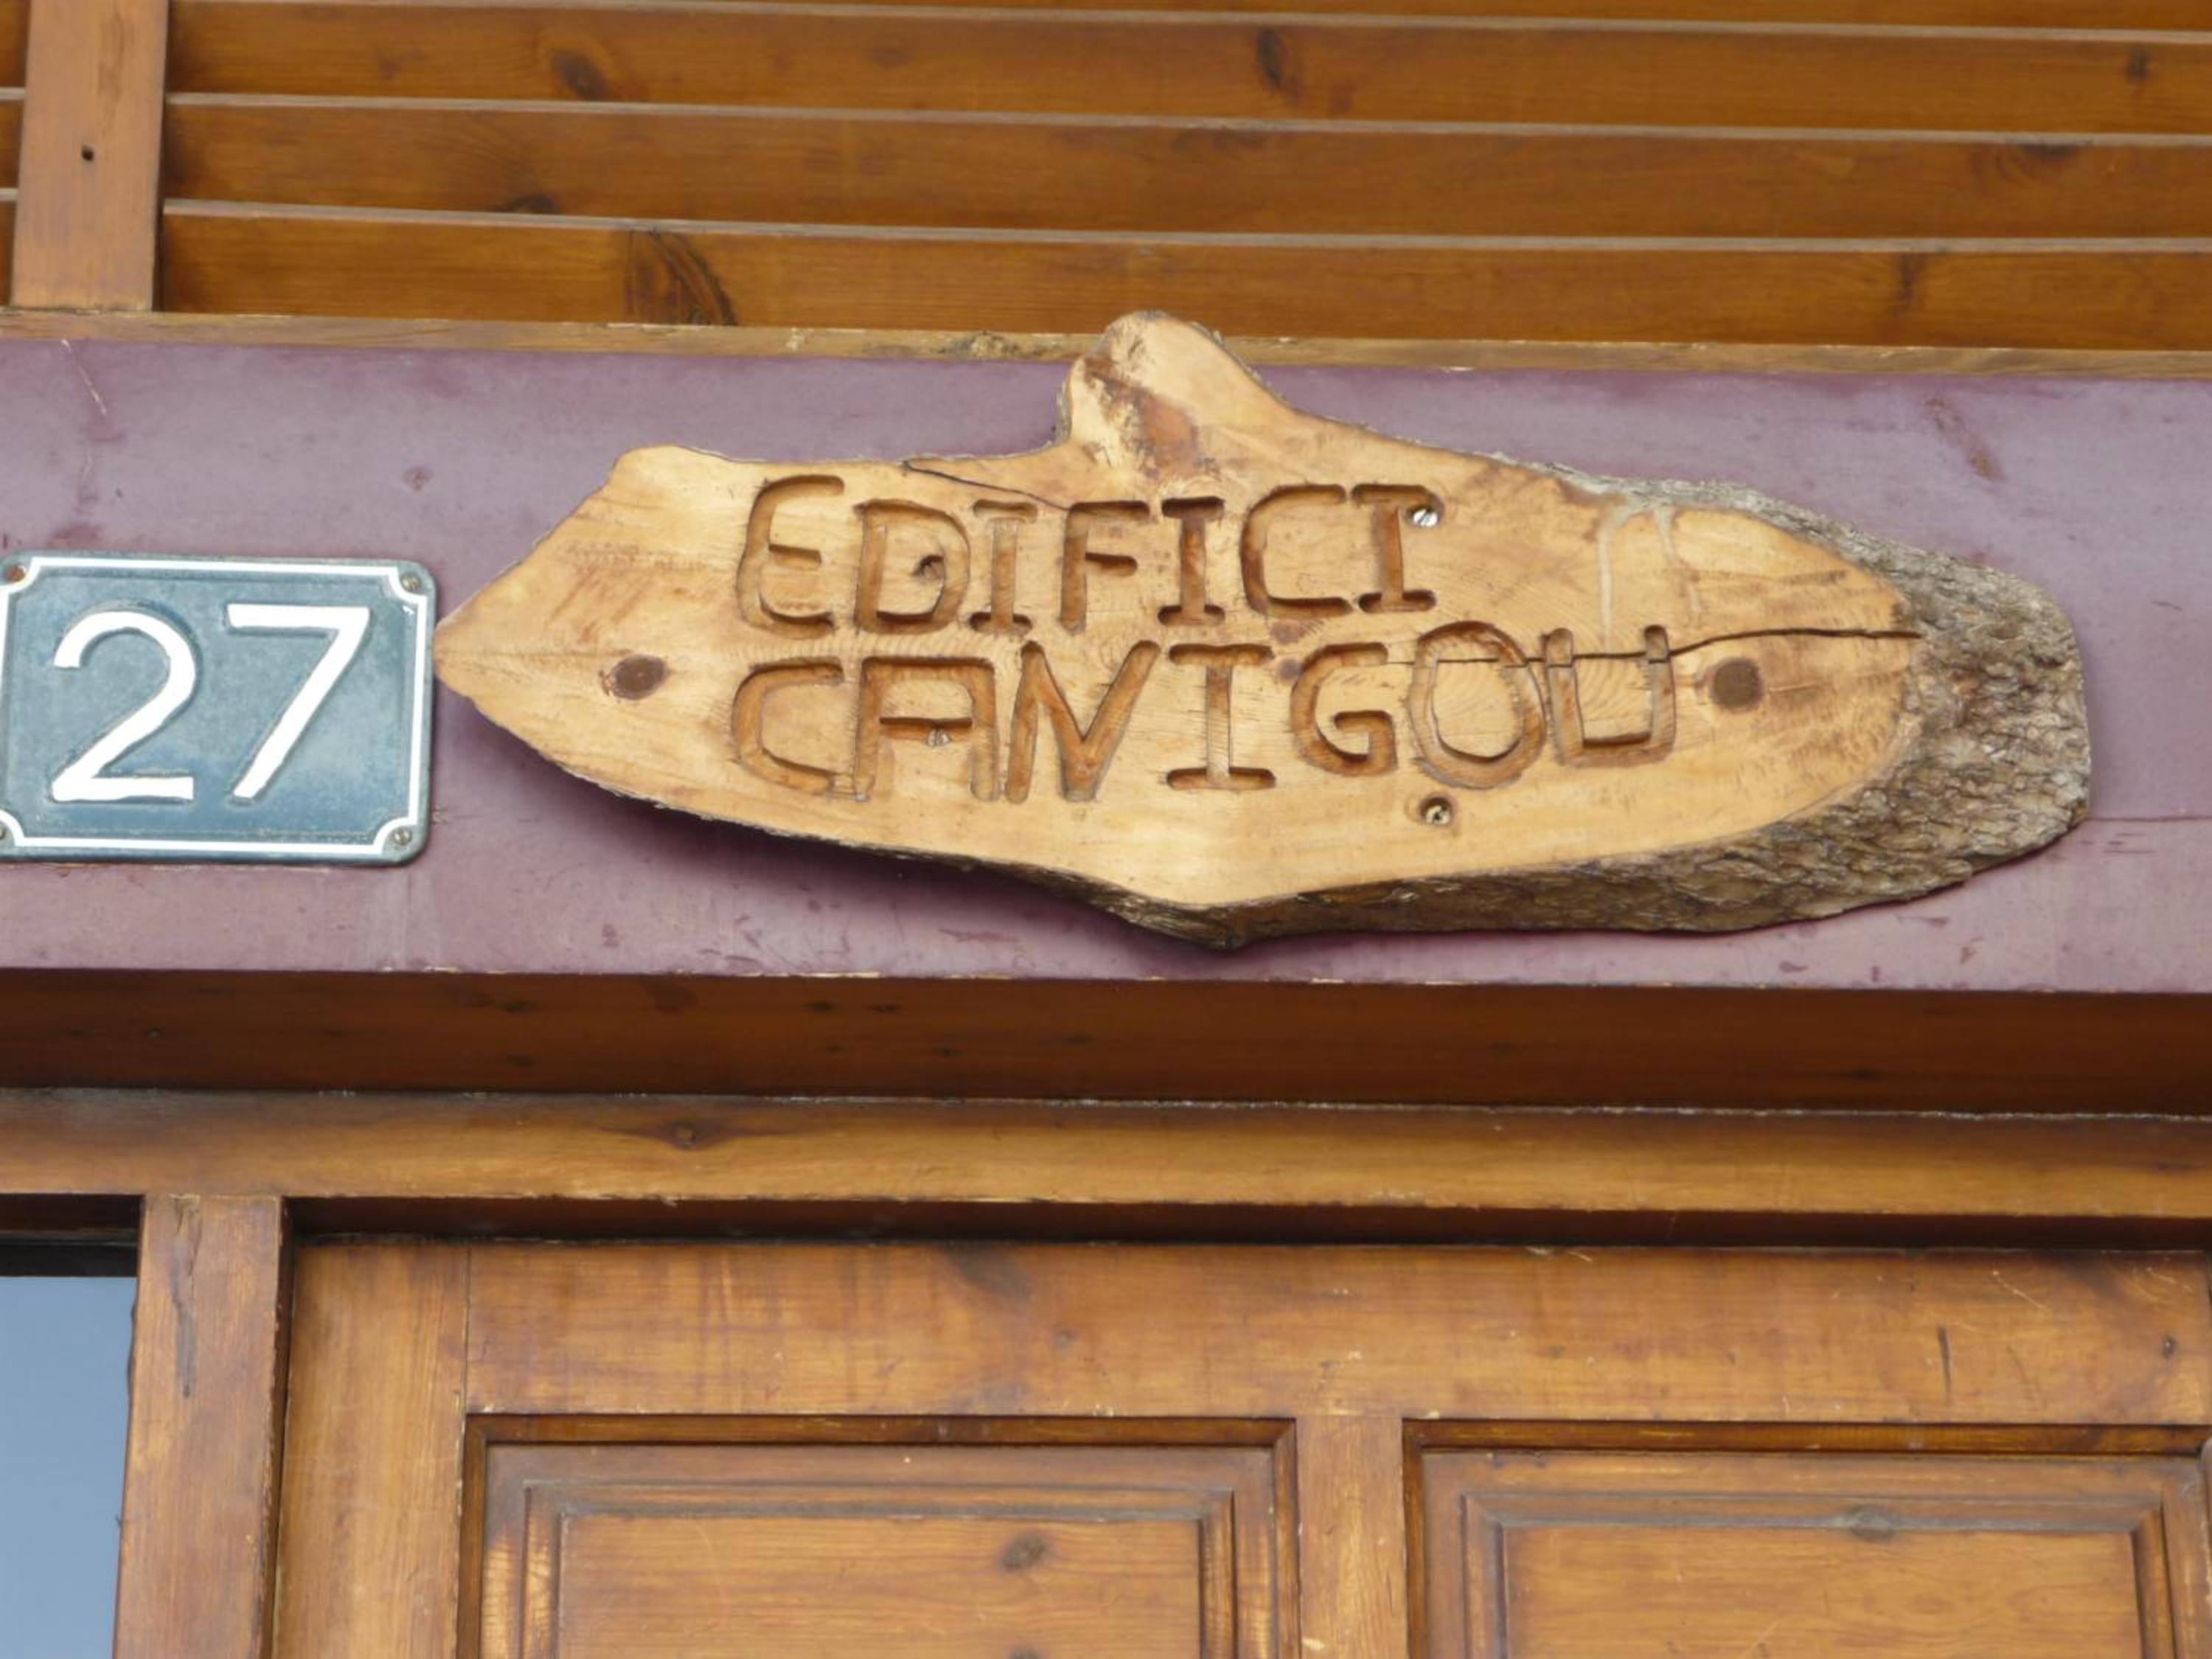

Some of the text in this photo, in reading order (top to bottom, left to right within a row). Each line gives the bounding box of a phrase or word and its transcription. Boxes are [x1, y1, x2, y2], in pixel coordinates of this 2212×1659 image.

[740, 474, 1439, 638] EDIFICI
[52, 604, 370, 802] 27
[731, 620, 1676, 802] CANIGOU
